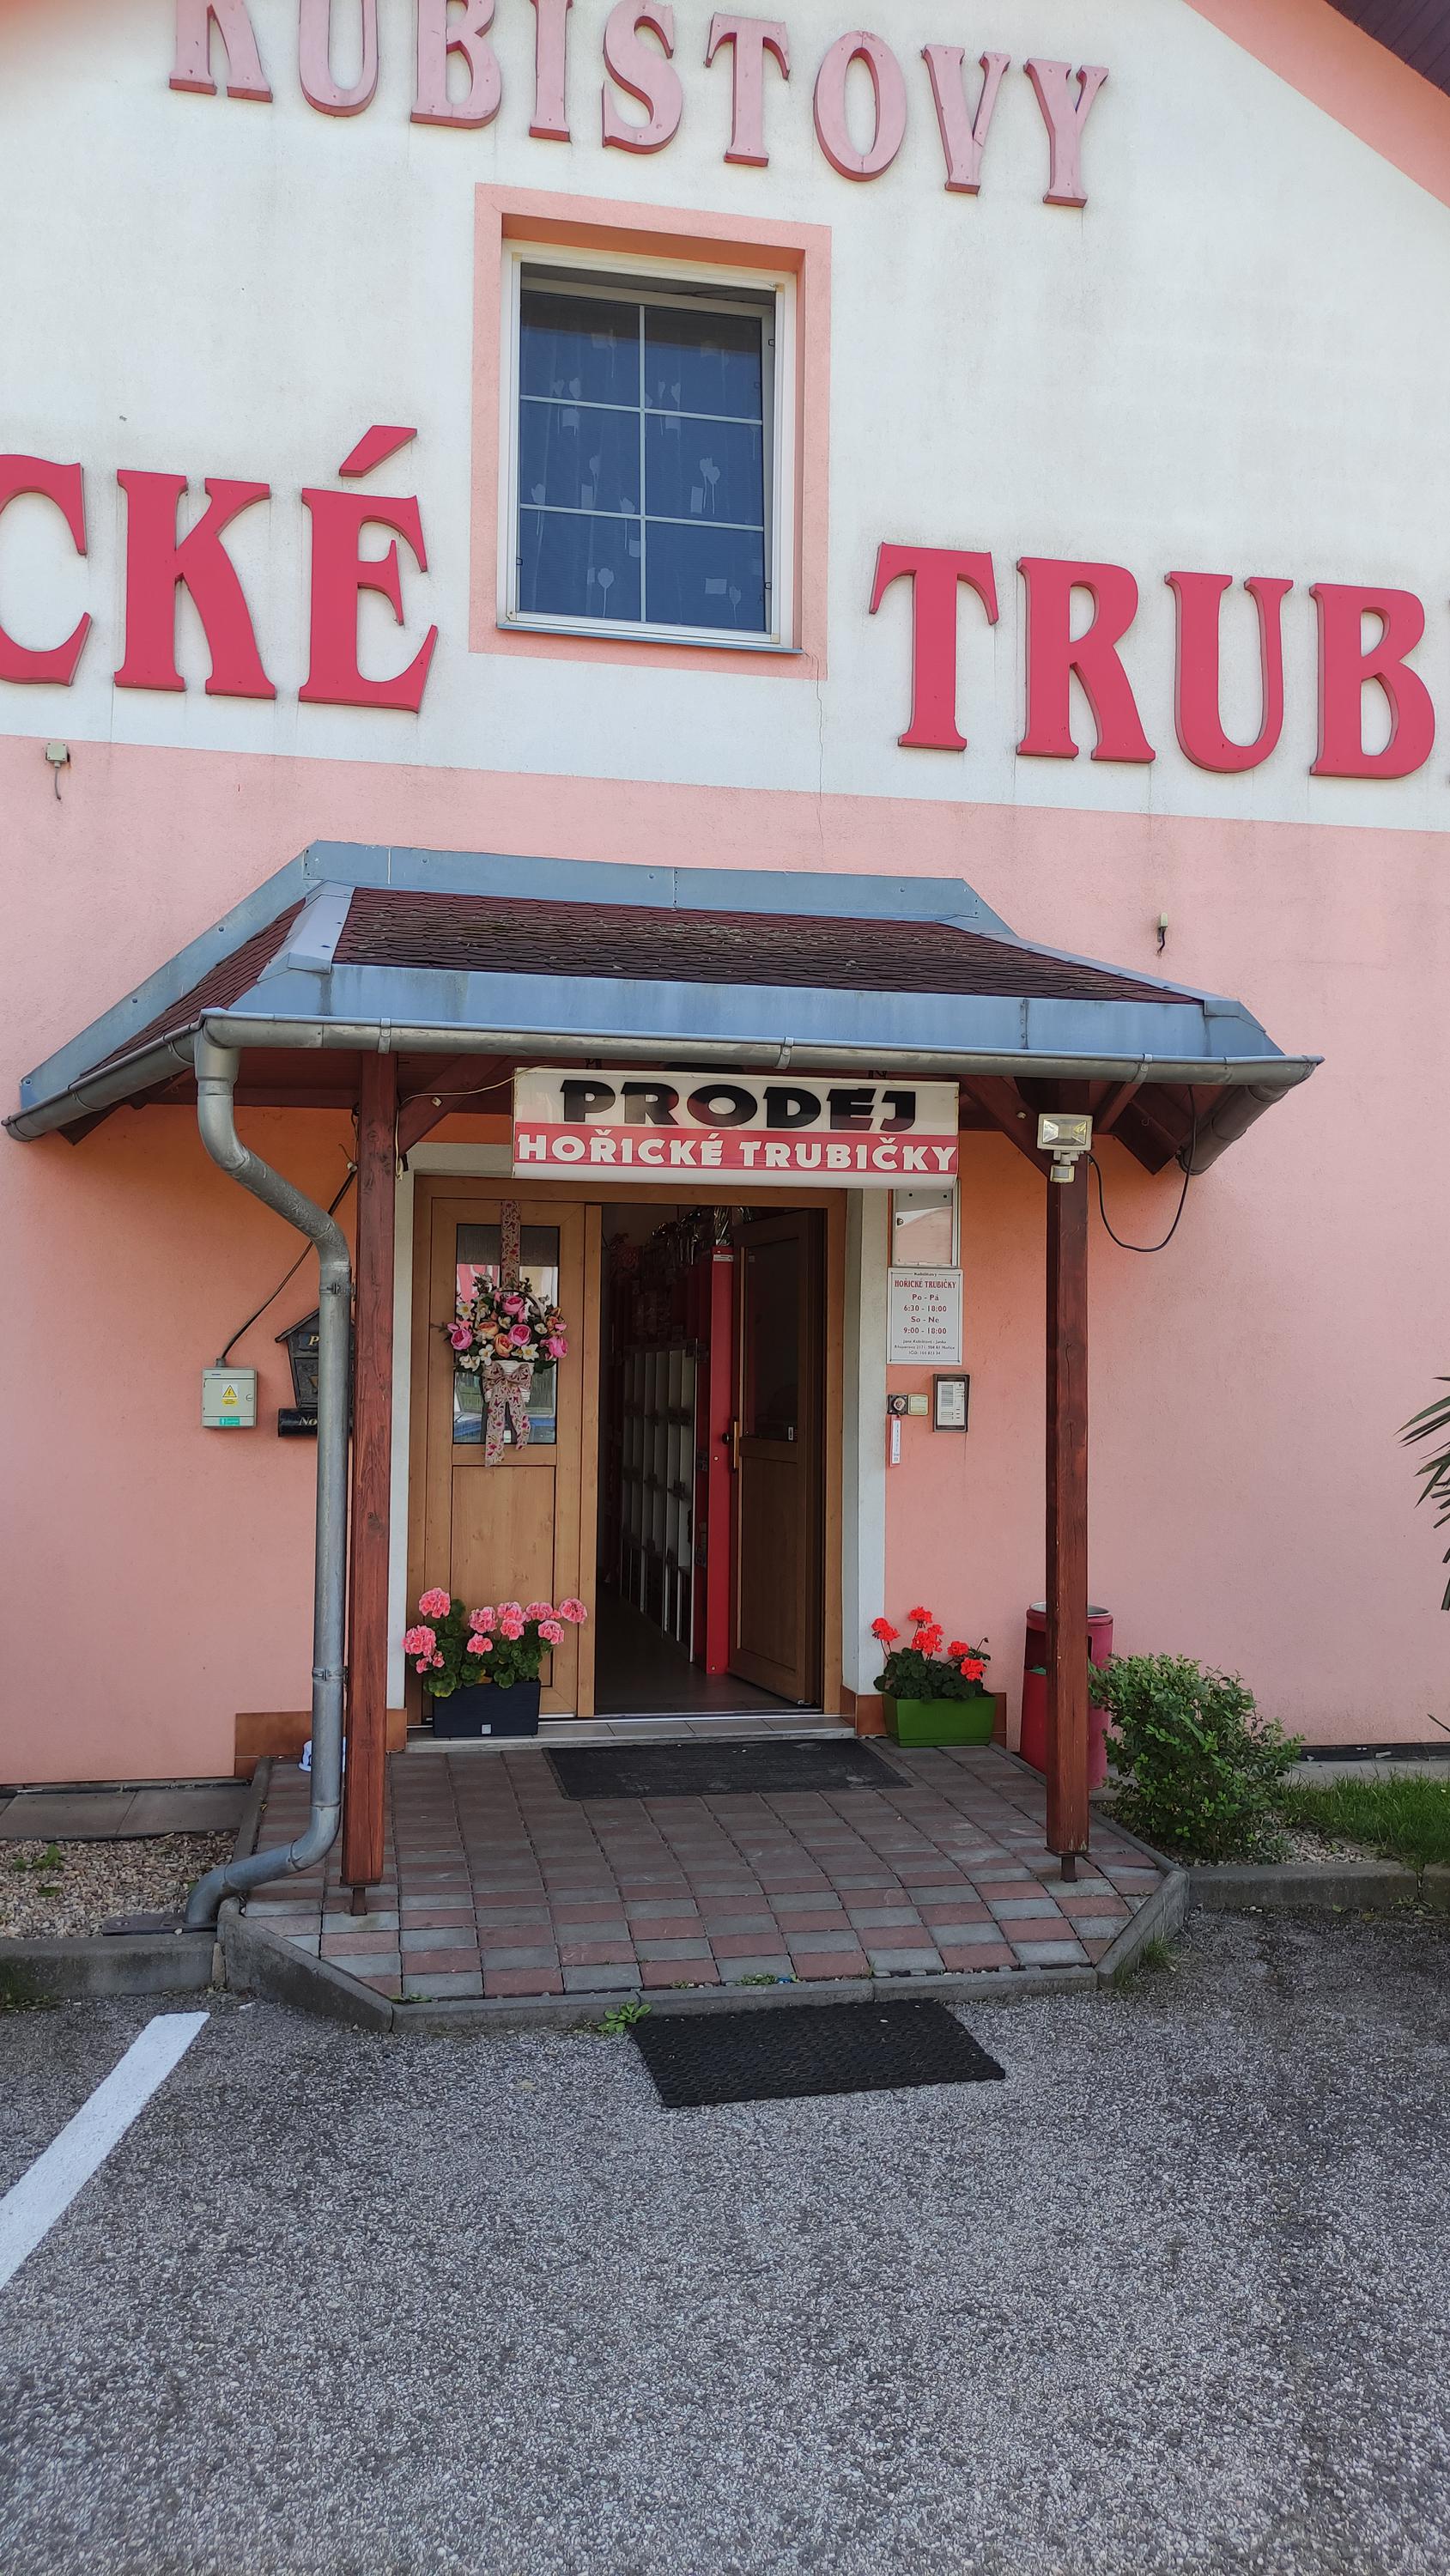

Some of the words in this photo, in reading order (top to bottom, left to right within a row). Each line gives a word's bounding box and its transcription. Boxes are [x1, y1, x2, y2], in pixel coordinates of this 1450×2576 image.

[869, 542, 1450, 780] TRUB
[560, 1078, 916, 1133] PRODEJ
[517, 1128, 724, 1166] HOŘICKÉ
[739, 1137, 957, 1171] TRUBIČKY
